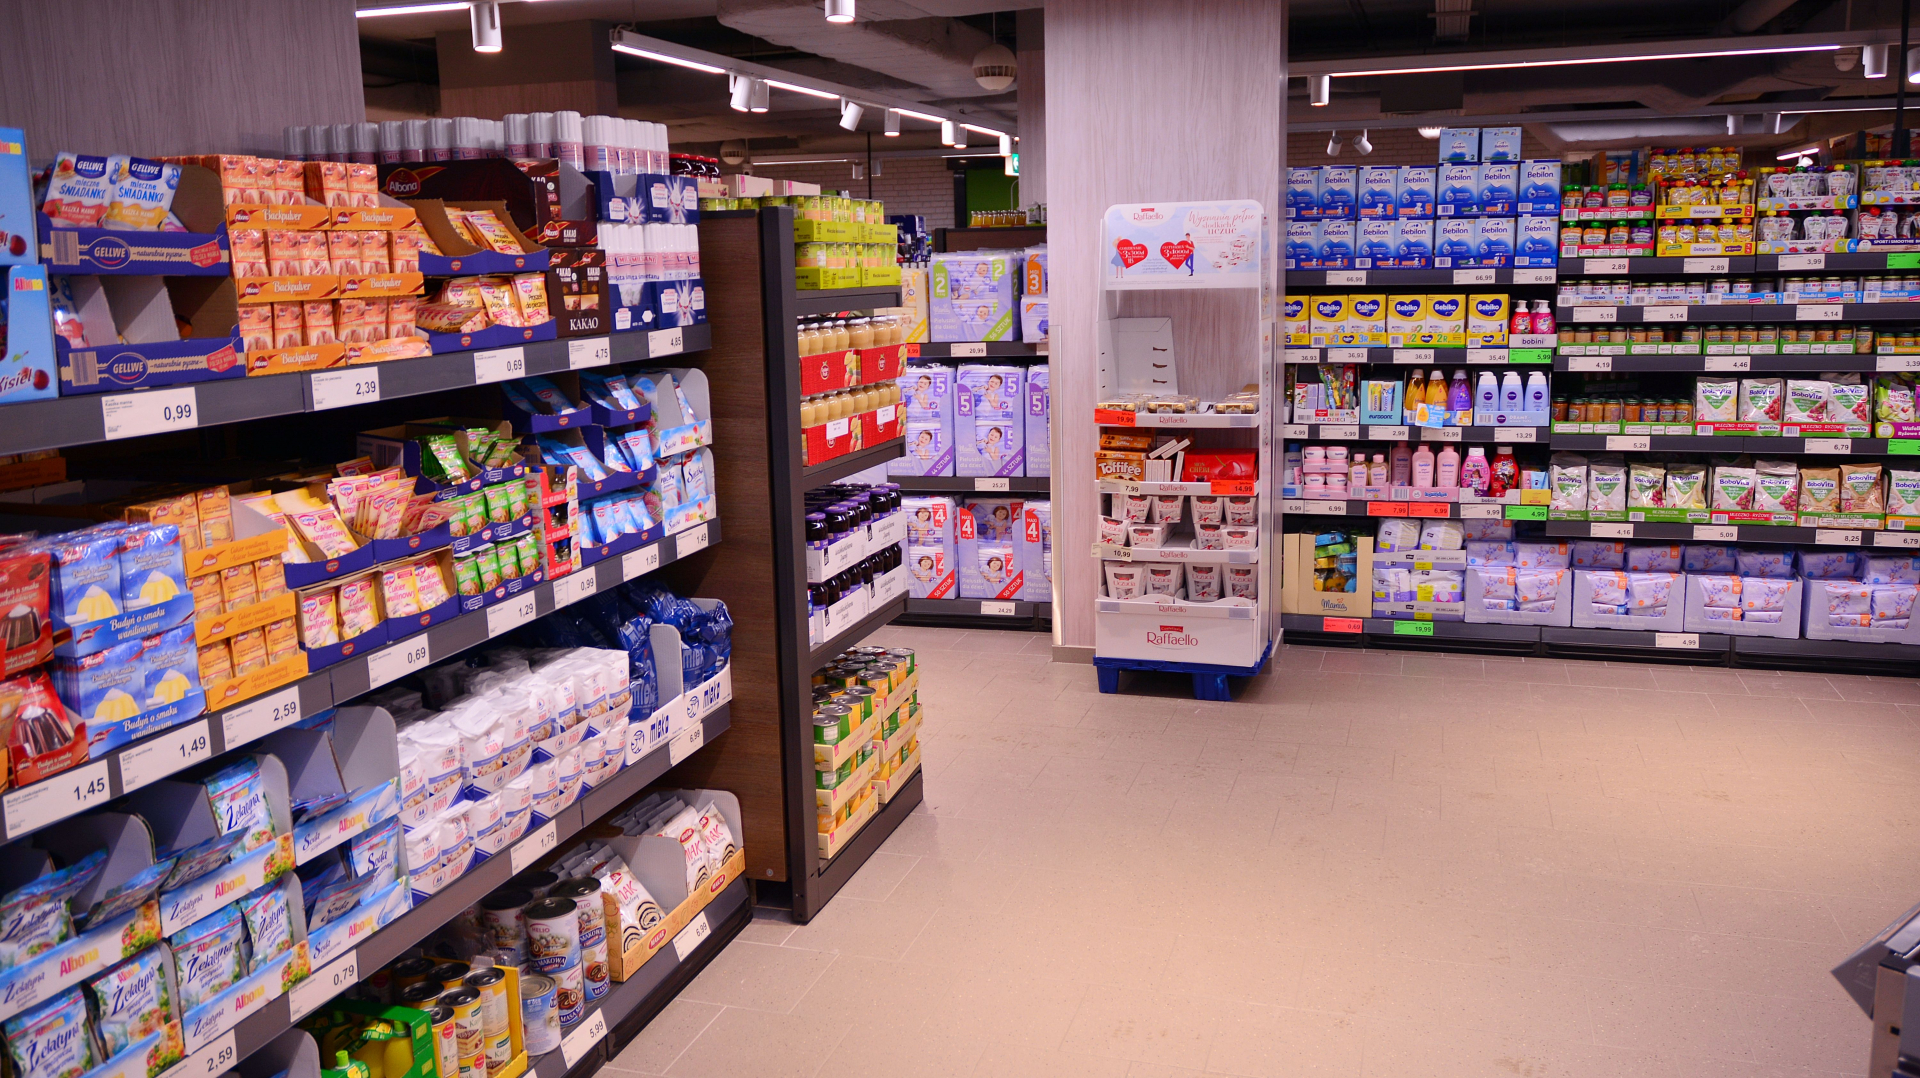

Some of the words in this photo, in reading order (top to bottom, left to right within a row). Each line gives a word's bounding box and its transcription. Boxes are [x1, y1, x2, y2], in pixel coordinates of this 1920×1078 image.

[77, 160, 103, 171] GELLWE
[131, 163, 160, 174] GELLWE
[75, 179, 100, 187] mleczne
[1485, 173, 1510, 181] Bebilon
[130, 181, 156, 190] mleczne
[389, 181, 417, 192] Albona
[262, 209, 302, 222] Backpulver
[1386, 204, 1394, 215] 5
[1425, 203, 1433, 215] 5
[360, 211, 393, 223] Backpulver
[1133, 212, 1163, 221] Raffaello
[564, 229, 576, 237] KAKAO
[1443, 227, 1468, 235] Bebilon
[1524, 225, 1551, 233] Bebilon
[94, 247, 126, 258] GELLWE
[587, 267, 600, 275] KAKAO
[995, 264, 1002, 276] 2
[273, 281, 312, 292] Backpulver
[369, 278, 402, 289] Backpulver
[936, 277, 945, 293] 2
[1030, 274, 1039, 290] 3
[570, 317, 598, 330] KAKAO
[671, 337, 681, 346] 4,85
[282, 352, 318, 363] Backpulver
[595, 348, 608, 358] 4,75
[113, 362, 143, 374] GELLWE
[507, 359, 522, 371] 0,69
[355, 382, 376, 395] 2,39
[936, 377, 946, 392] 5
[1007, 378, 1017, 392] 5
[1032, 395, 1042, 410] 5
[1791, 391, 1822, 400] BoboVita
[960, 395, 970, 411] 5
[164, 404, 191, 421] 0,99
[1160, 416, 1187, 424] Raffaello
[1099, 462, 1141, 476] Toffifee
[935, 509, 946, 522] 4
[314, 524, 333, 533] Cukier
[962, 520, 972, 534] 4
[1027, 523, 1037, 537] 4
[697, 534, 707, 544] 1,49
[1113, 550, 1131, 558] 10,99
[1160, 551, 1188, 559] Raffaello
[388, 584, 406, 594] Cukier
[581, 577, 594, 591] 0,99
[349, 595, 365, 605] Cukier
[309, 610, 325, 620] Cukier
[519, 603, 534, 618] 1,29
[1158, 605, 1187, 613] Raffaello
[110, 619, 135, 631] Budyń
[142, 607, 165, 622] smaku
[118, 622, 158, 640] waniliowym
[1415, 625, 1432, 633] 19,99
[1146, 631, 1198, 648] Raffaello
[407, 646, 426, 664] 0,69
[703, 681, 720, 708] mleko
[123, 717, 148, 732] Budyń
[156, 706, 177, 721] smaku
[273, 702, 296, 722] 2,59
[650, 714, 669, 741] mleko
[690, 729, 700, 744] 6,99
[179, 736, 206, 757] 1,49
[74, 777, 105, 801] 1,45
[339, 812, 364, 833] Albona
[303, 832, 321, 851] Soda
[540, 832, 554, 849] 1,79
[368, 850, 387, 873] Soda
[215, 874, 246, 898] Albona
[170, 893, 203, 922] Żelatyna
[348, 916, 373, 938] Albona
[696, 921, 708, 937] 6,99
[314, 939, 330, 959] Soda
[60, 947, 99, 977] Albona
[187, 942, 233, 984] Żelatyna
[333, 964, 354, 986] 0,79
[4, 971, 44, 1004] Żelatyna
[111, 967, 154, 1017] Żelatyna
[235, 985, 265, 1012] Albona
[193, 1008, 224, 1038] Żelatyna
[590, 1020, 603, 1038] 5,99
[26, 1022, 79, 1074] Żelatyna
[207, 1046, 233, 1072] 2,59
